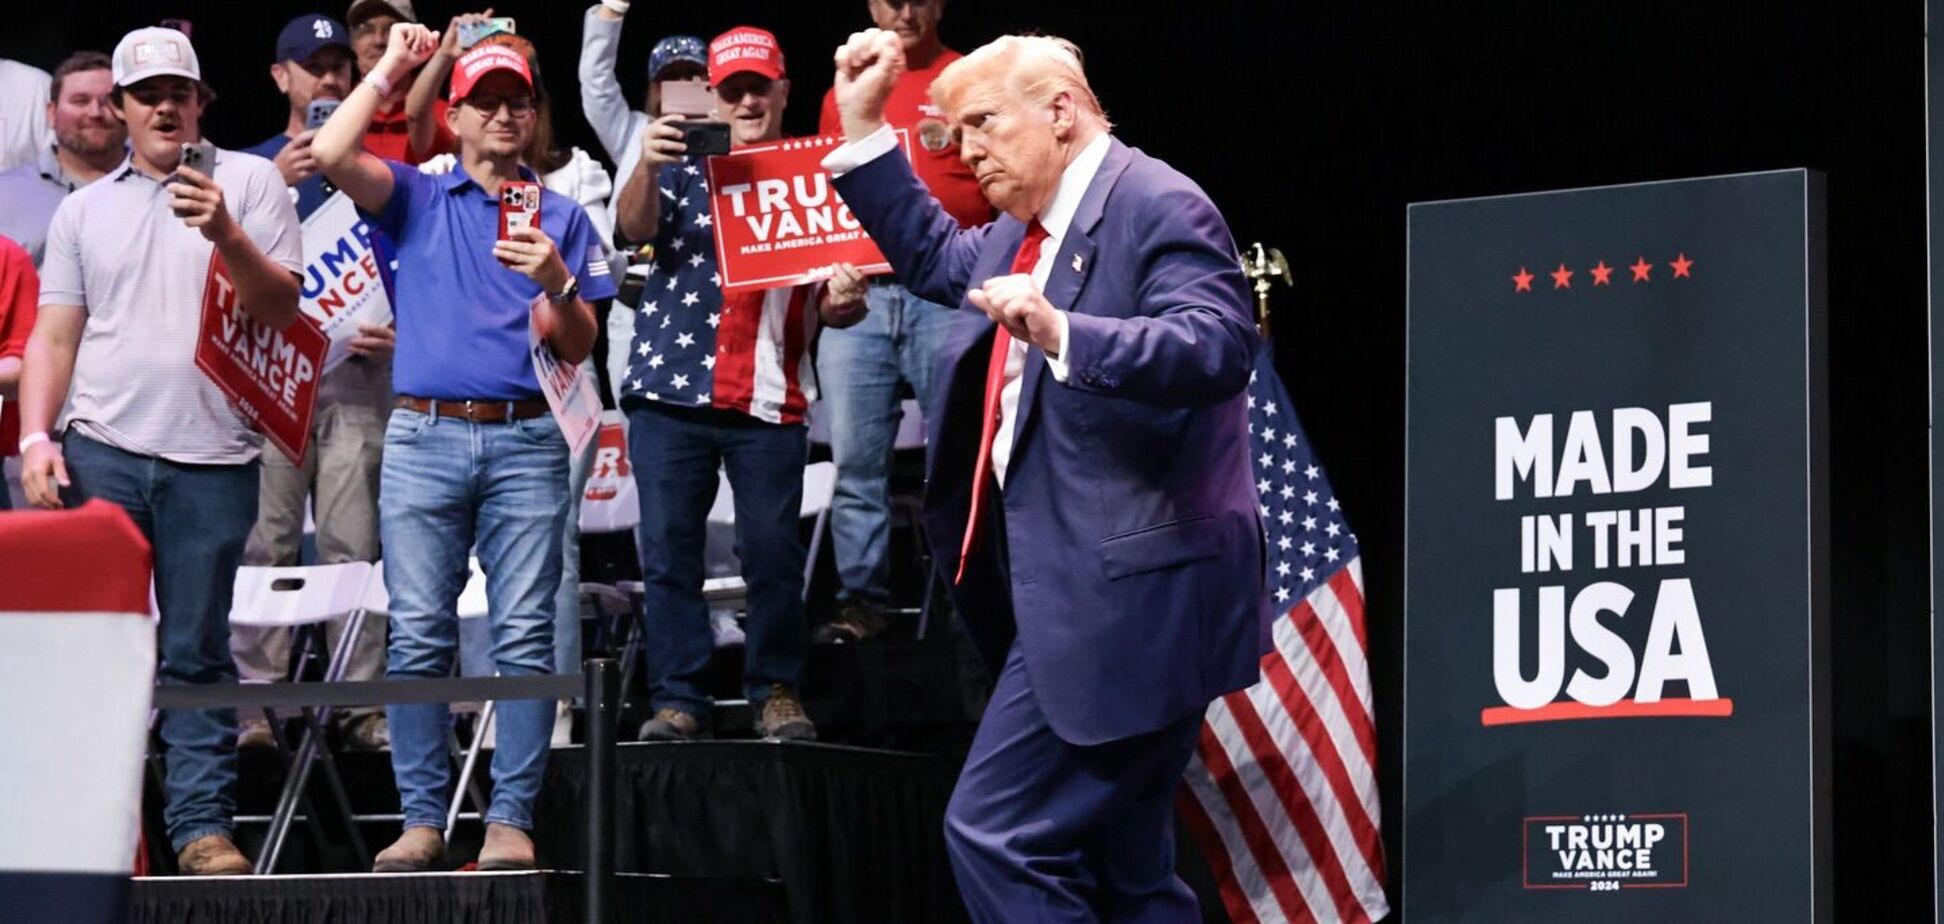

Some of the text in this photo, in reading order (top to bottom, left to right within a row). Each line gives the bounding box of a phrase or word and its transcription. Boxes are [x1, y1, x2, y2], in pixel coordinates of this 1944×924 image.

[721, 172, 844, 218] TRU
[740, 242, 772, 255] MAKE
[774, 235, 825, 251] AMERICA
[825, 230, 860, 244] GREAT
[746, 205, 861, 242] VANC
[301, 219, 372, 299] UMP
[305, 254, 378, 326] NCE
[222, 313, 298, 408] VANCE
[1495, 401, 1712, 500] MADE
[1521, 506, 1685, 573] IN THE
[1493, 578, 1719, 710] USA
[1545, 823, 1665, 850] TRUMP
[1558, 849, 1651, 870] VANCE
[1590, 881, 1620, 891] 2024
